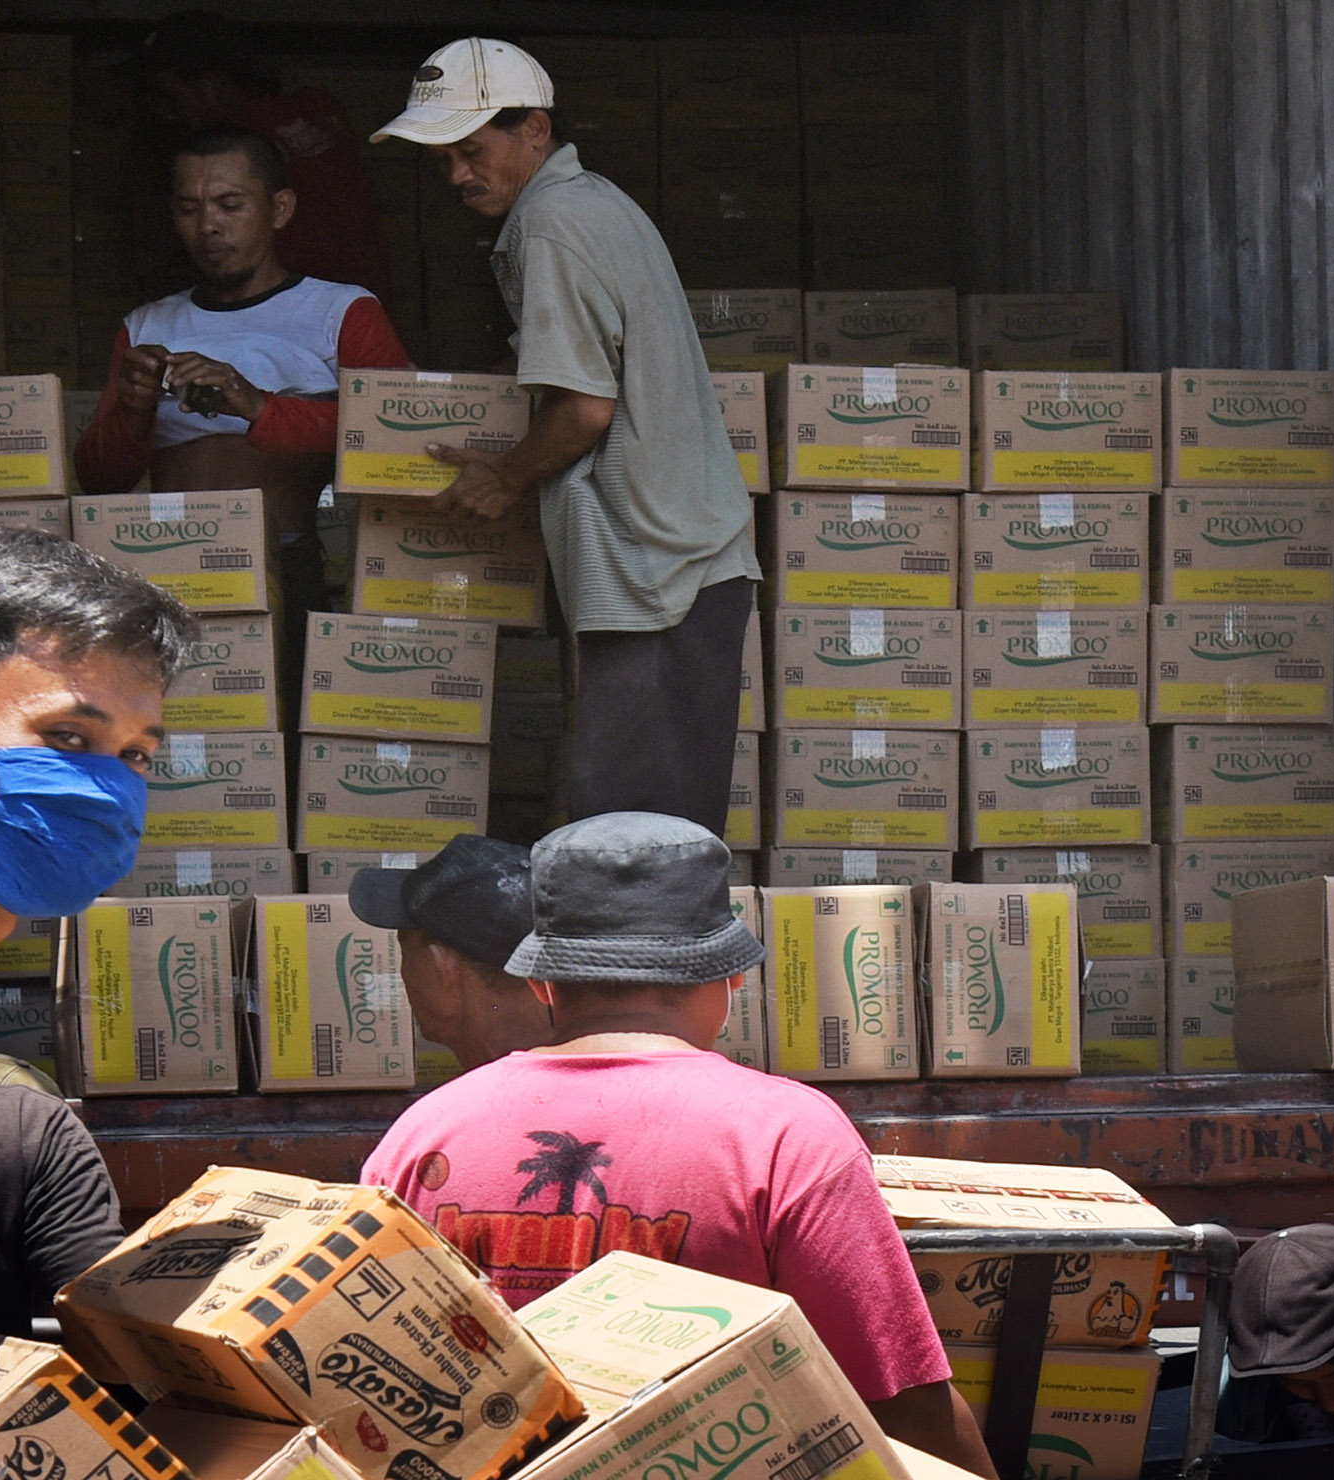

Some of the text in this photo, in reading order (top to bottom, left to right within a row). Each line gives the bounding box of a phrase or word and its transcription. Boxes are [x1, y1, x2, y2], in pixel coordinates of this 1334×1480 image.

[382, 399, 487, 424] PROMOO
[1027, 397, 1125, 422] PROMOO
[1213, 395, 1308, 420] PROMOO
[116, 519, 219, 543] PROMOO
[821, 517, 921, 544] PROMOO
[1207, 515, 1304, 541] PROMOO
[350, 641, 454, 668] PROMOO
[344, 762, 447, 788] PROMOO
[818, 758, 919, 784] PROMOO
[351, 936, 377, 1045] PROMOO
[862, 931, 884, 1036] PROMOO
[966, 925, 988, 1034] PROMOO
[172, 941, 200, 1049] PROMOO
[392, 1310, 473, 1396] Bumbu Ekstrak
[411, 1305, 481, 1380] Daging Ayam
[276, 1355, 306, 1383] KALDU
[347, 1334, 423, 1390] DAGING PILIHAN
[9, 1398, 40, 1427] KALDU
[321, 1354, 464, 1443] Masako
